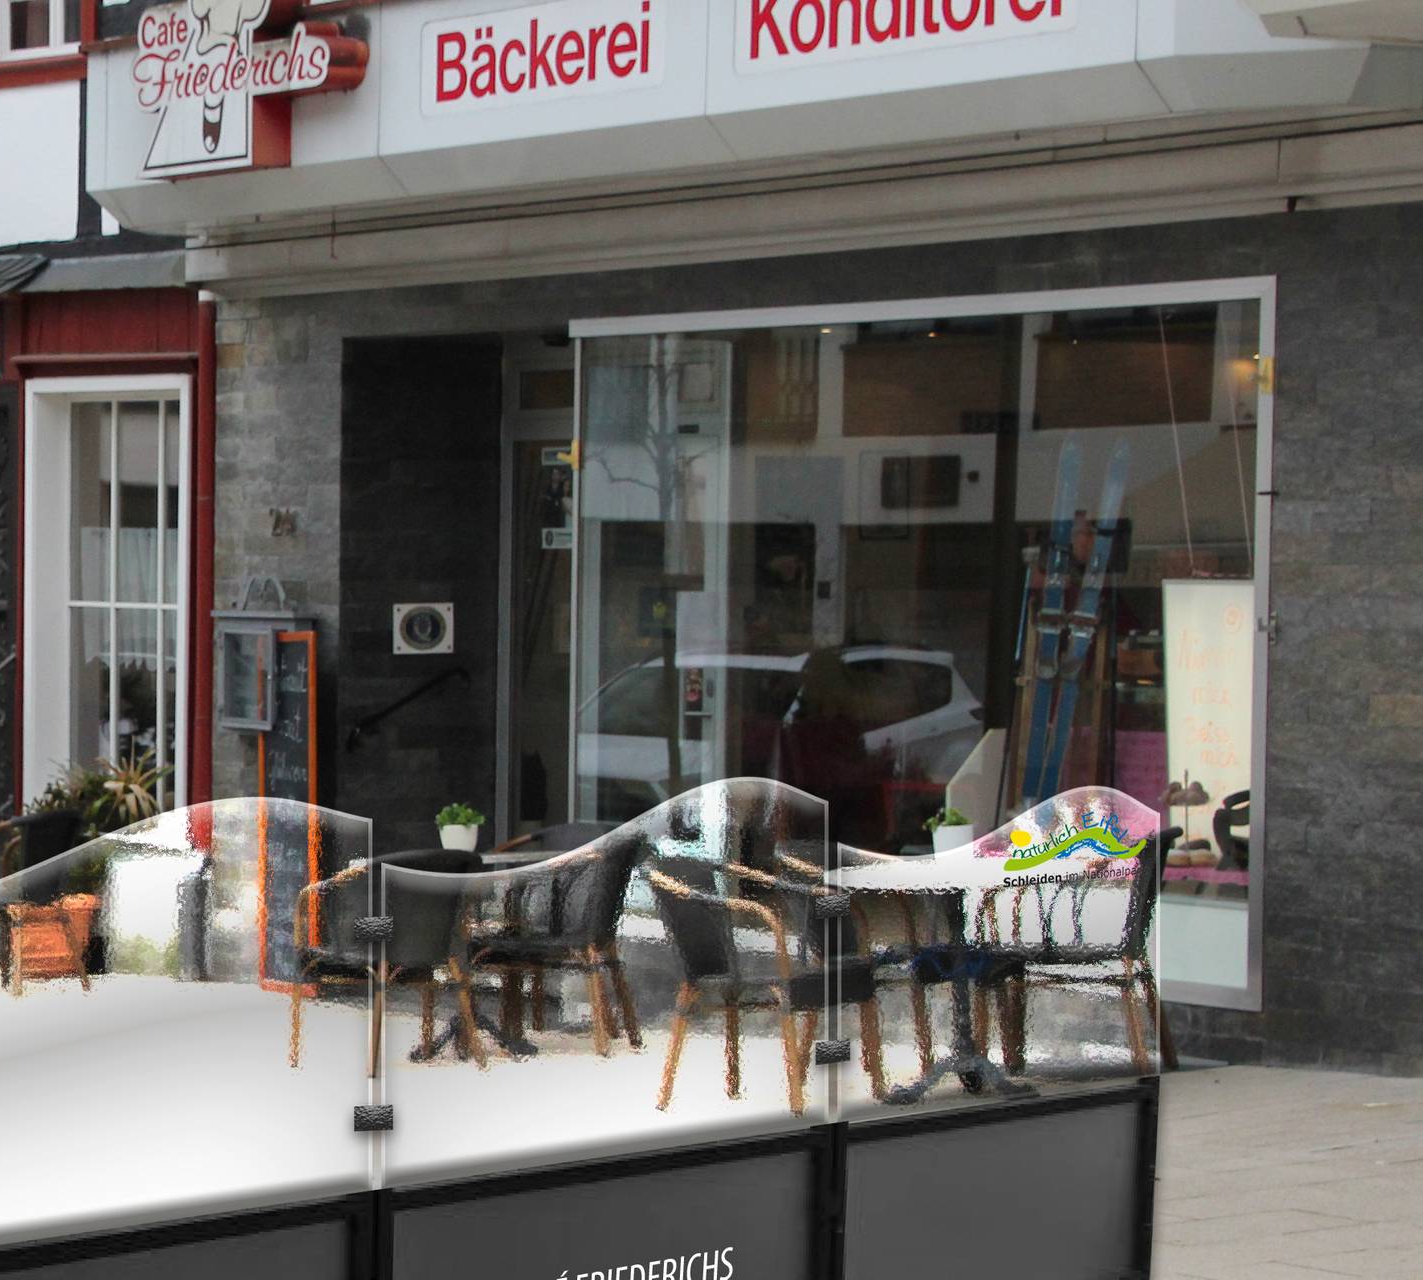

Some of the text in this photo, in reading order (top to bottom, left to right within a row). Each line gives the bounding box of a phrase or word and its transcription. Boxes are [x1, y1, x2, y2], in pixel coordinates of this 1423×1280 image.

[141, 14, 188, 49] Cafe
[436, 0, 650, 102] Bäckerei
[133, 31, 326, 107] Friederichs
[1081, 812, 1128, 842] Eifel
[1003, 874, 1062, 888] Schleiden
[1082, 866, 1140, 881] Nationalpa
